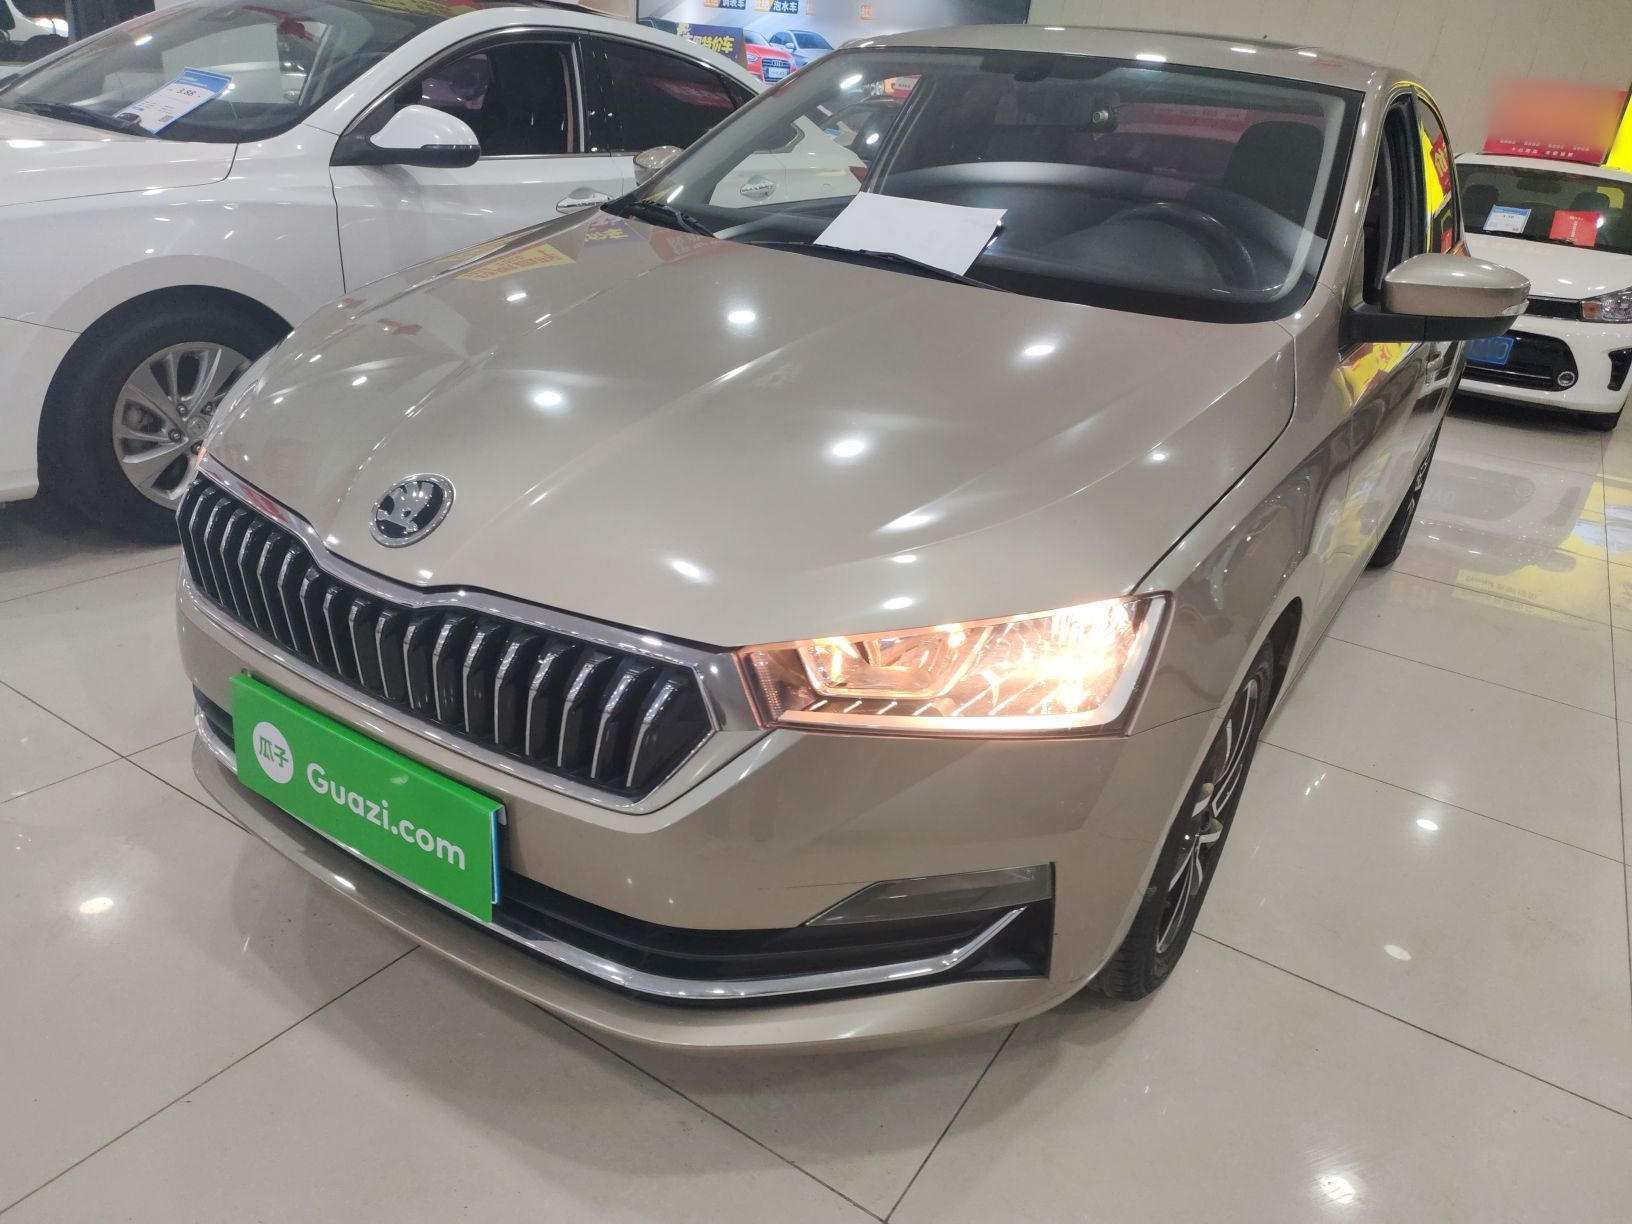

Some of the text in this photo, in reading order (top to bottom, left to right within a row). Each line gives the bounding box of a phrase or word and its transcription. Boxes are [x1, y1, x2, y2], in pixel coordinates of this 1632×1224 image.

[771, 0, 798, 12] 泡水车
[259, 735, 289, 768] 瓜子
[306, 762, 466, 872] Guazi.com
